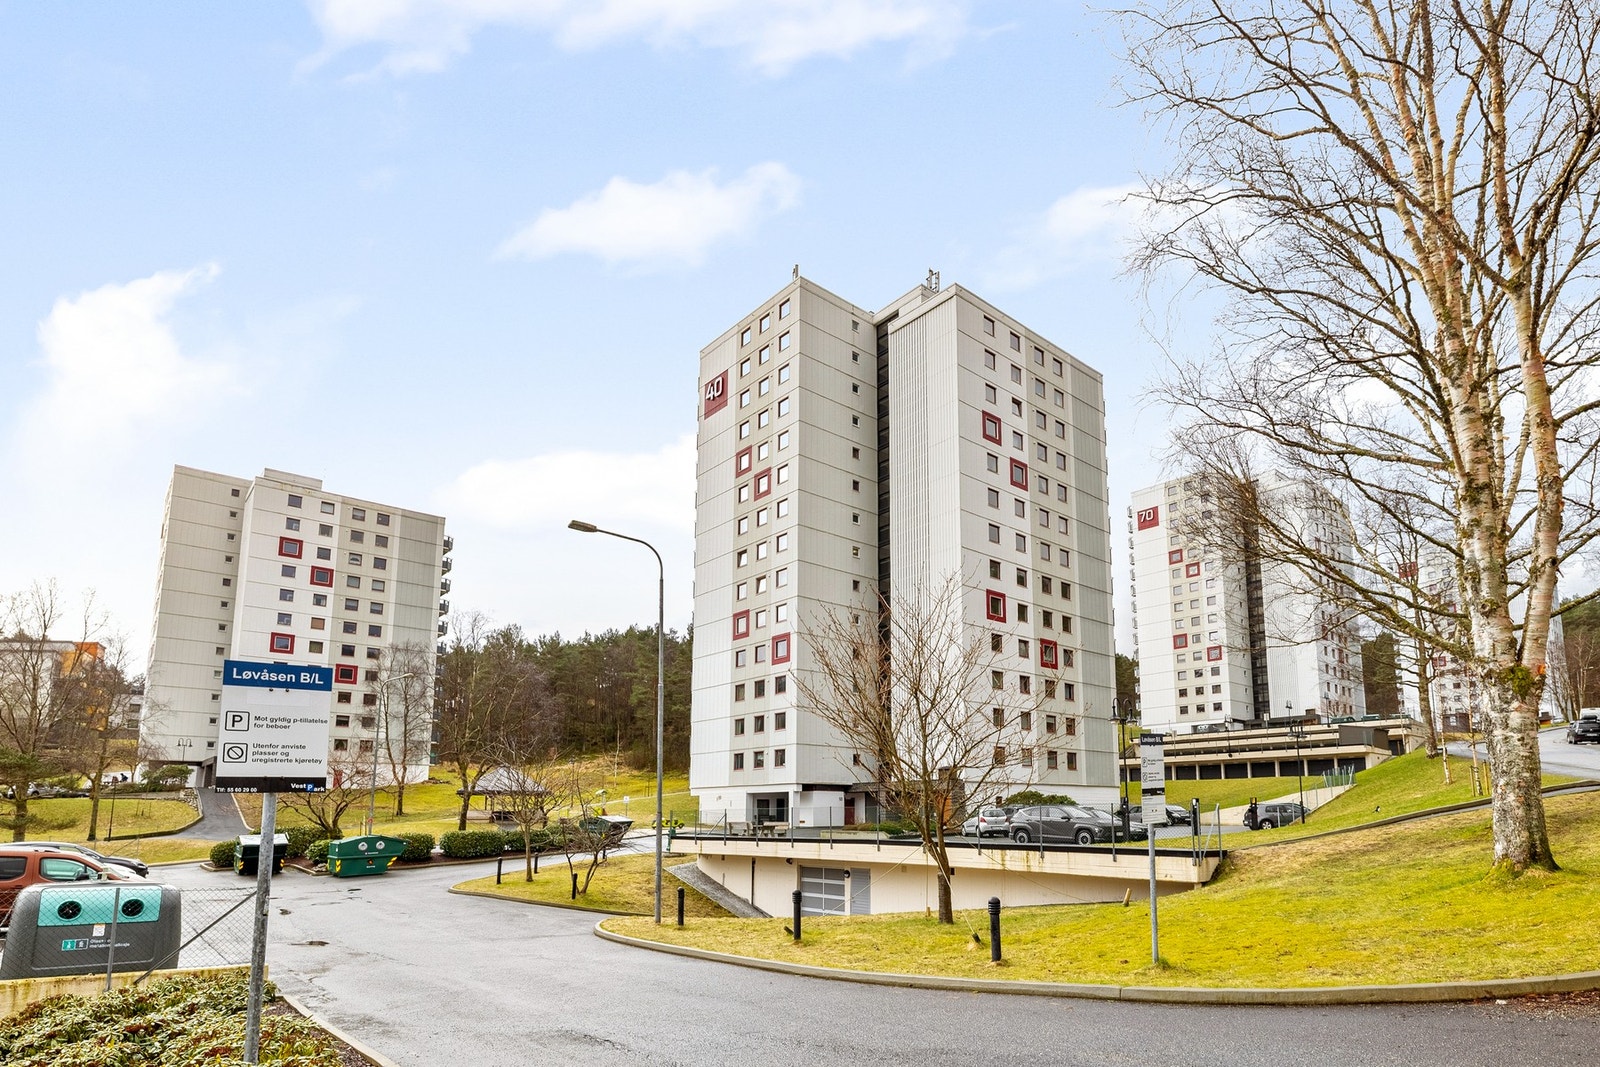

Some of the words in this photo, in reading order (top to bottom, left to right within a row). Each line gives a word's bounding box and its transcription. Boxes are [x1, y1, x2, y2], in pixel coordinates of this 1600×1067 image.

[705, 376, 724, 401] 40
[1138, 509, 1154, 523] 70
[232, 667, 296, 683] Løvåsen
[300, 672, 324, 685] B/L
[231, 714, 243, 728] P
[269, 716, 292, 724] gyldig
[292, 717, 328, 725] p-tillatelse
[294, 757, 323, 765] kjøretøy
